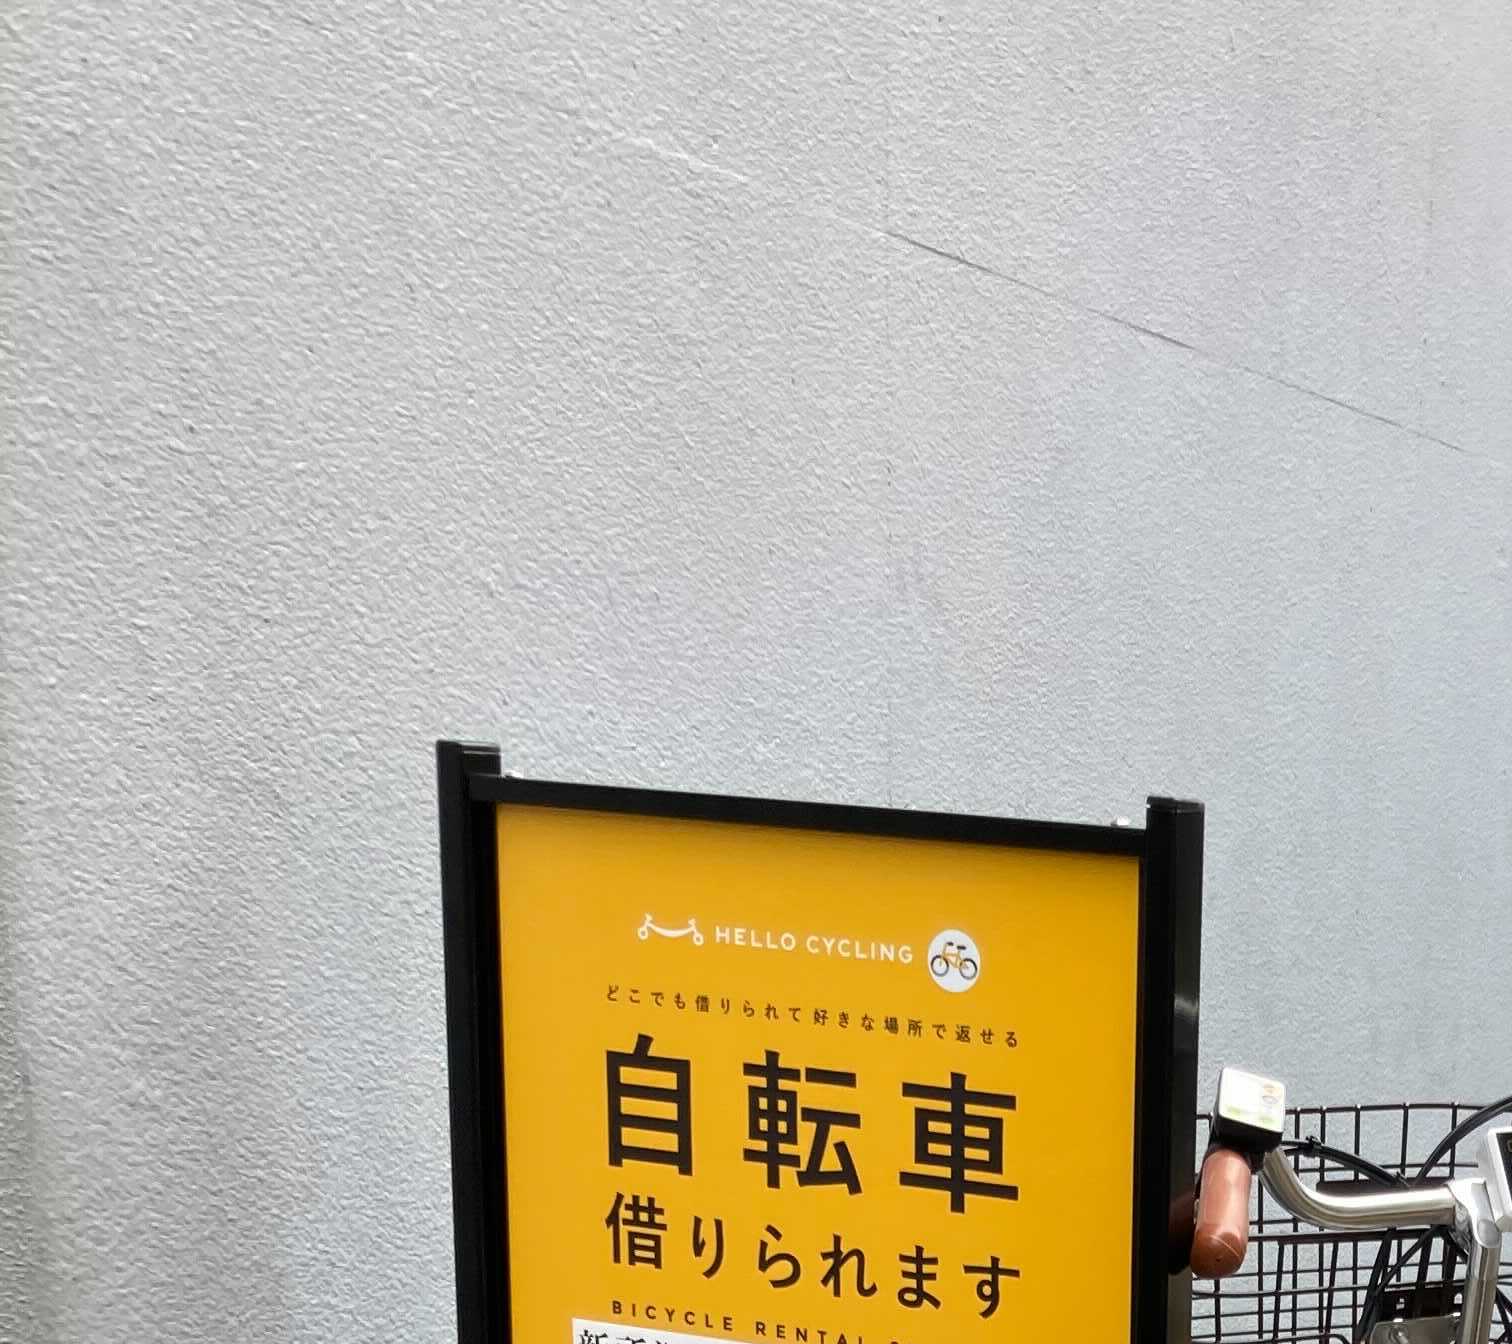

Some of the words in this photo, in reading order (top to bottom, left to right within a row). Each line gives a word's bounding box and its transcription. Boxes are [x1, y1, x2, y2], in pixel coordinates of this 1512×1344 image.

[714, 924, 797, 953] HELLO
[806, 935, 914, 965] CYCLING
[606, 983, 1020, 1049] どこでも借りられて好きな場所で返せる
[605, 1032, 1020, 1214] 自転車
[605, 1191, 1021, 1319] 借りられます
[611, 1300, 737, 1332] BICYCLE
